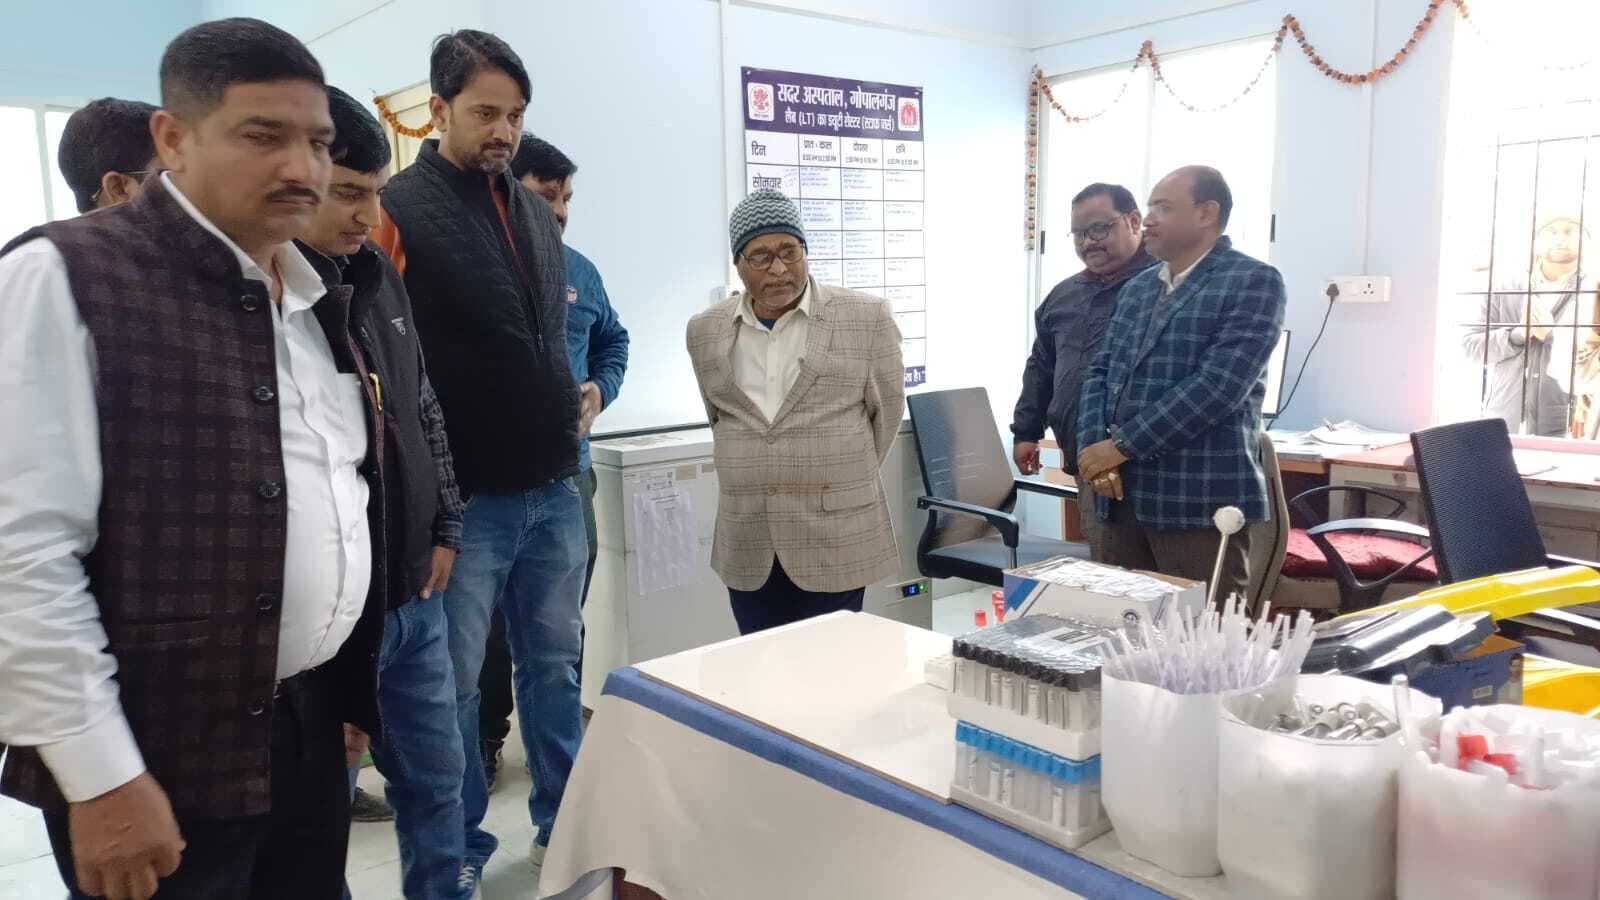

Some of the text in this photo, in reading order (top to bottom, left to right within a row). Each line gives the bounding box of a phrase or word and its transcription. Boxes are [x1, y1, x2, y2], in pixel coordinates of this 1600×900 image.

[777, 83, 896, 112] सदर अस्पताल, गोपालगंज
[799, 111, 815, 127] (LT)
[817, 113, 827, 126] का
[752, 172, 782, 190] सोमवार
